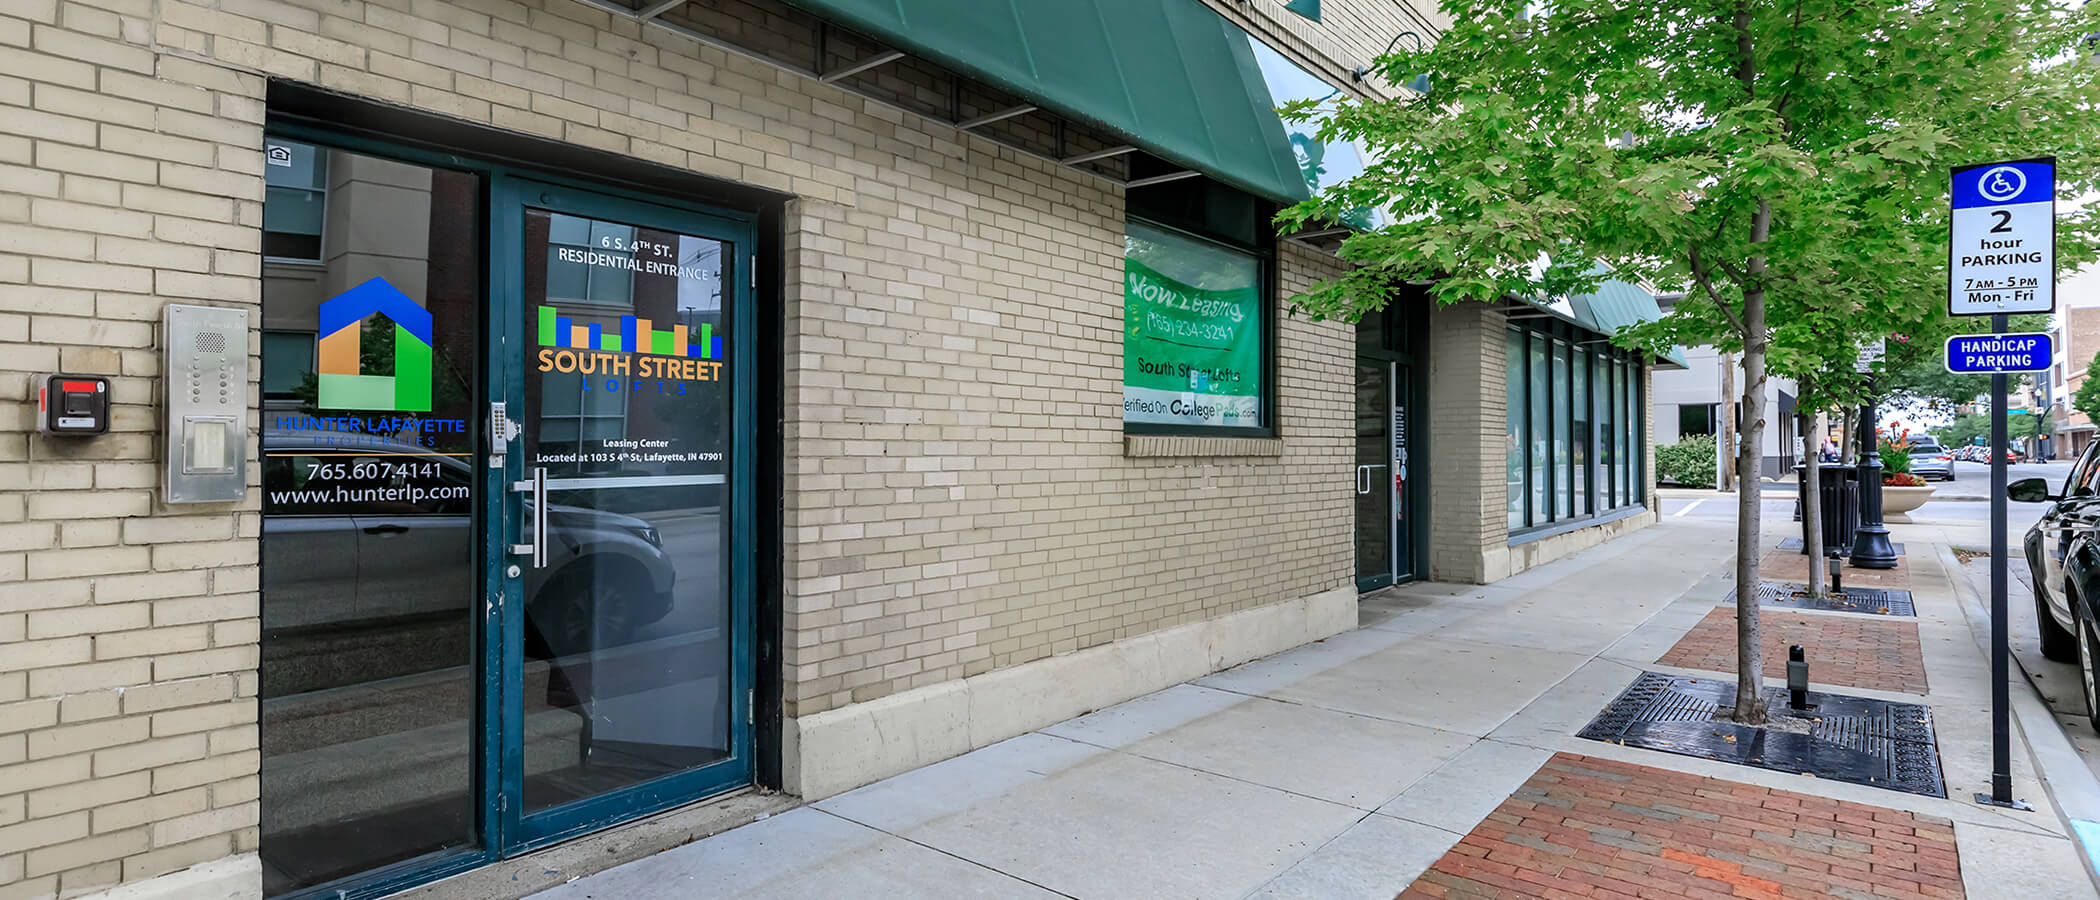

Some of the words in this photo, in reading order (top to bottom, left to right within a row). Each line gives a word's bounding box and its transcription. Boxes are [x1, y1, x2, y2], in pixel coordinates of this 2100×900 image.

[1990, 210, 2012, 233] 2
[601, 236, 610, 248] 6
[614, 238, 627, 250] S.
[653, 244, 673, 258] ST.
[1981, 239, 2023, 250] hour
[558, 248, 643, 271] RESIDENTIAL
[646, 261, 708, 281] ENTRANCE
[1962, 252, 2042, 267] PARKING
[1965, 278, 1974, 289] 7
[1976, 280, 1994, 288] AM
[2007, 276, 2016, 287] 5
[2020, 278, 2038, 286] PM
[1968, 292, 2001, 303] Mon
[2015, 290, 2034, 301] Fri
[1177, 290, 1244, 322] Leasing
[1961, 340, 2036, 353] HANDICAP
[537, 349, 631, 377] SOUTH
[638, 356, 723, 382] STREET
[1138, 357, 1175, 376] South
[1966, 354, 2032, 367] PARKING
[582, 377, 687, 395] LOFTS
[1123, 398, 1154, 414] erified
[1155, 400, 1168, 414] On
[277, 416, 361, 431] HUNTER
[367, 417, 466, 433] LAFAYETTE
[314, 435, 435, 447] PROPERTIES
[603, 439, 639, 450] Leasing
[640, 439, 669, 448] Center
[536, 453, 576, 463] Located
[578, 454, 588, 462] at
[590, 453, 607, 462] 103
[609, 453, 616, 462] S
[617, 452, 630, 462] 4th
[630, 453, 642, 463] St,
[644, 452, 686, 463] Lafayette,
[688, 453, 697, 461] IN
[699, 452, 722, 461] 47901
[307, 463, 441, 481] 765.607.4141
[271, 484, 470, 504] www.hunterlp.com
